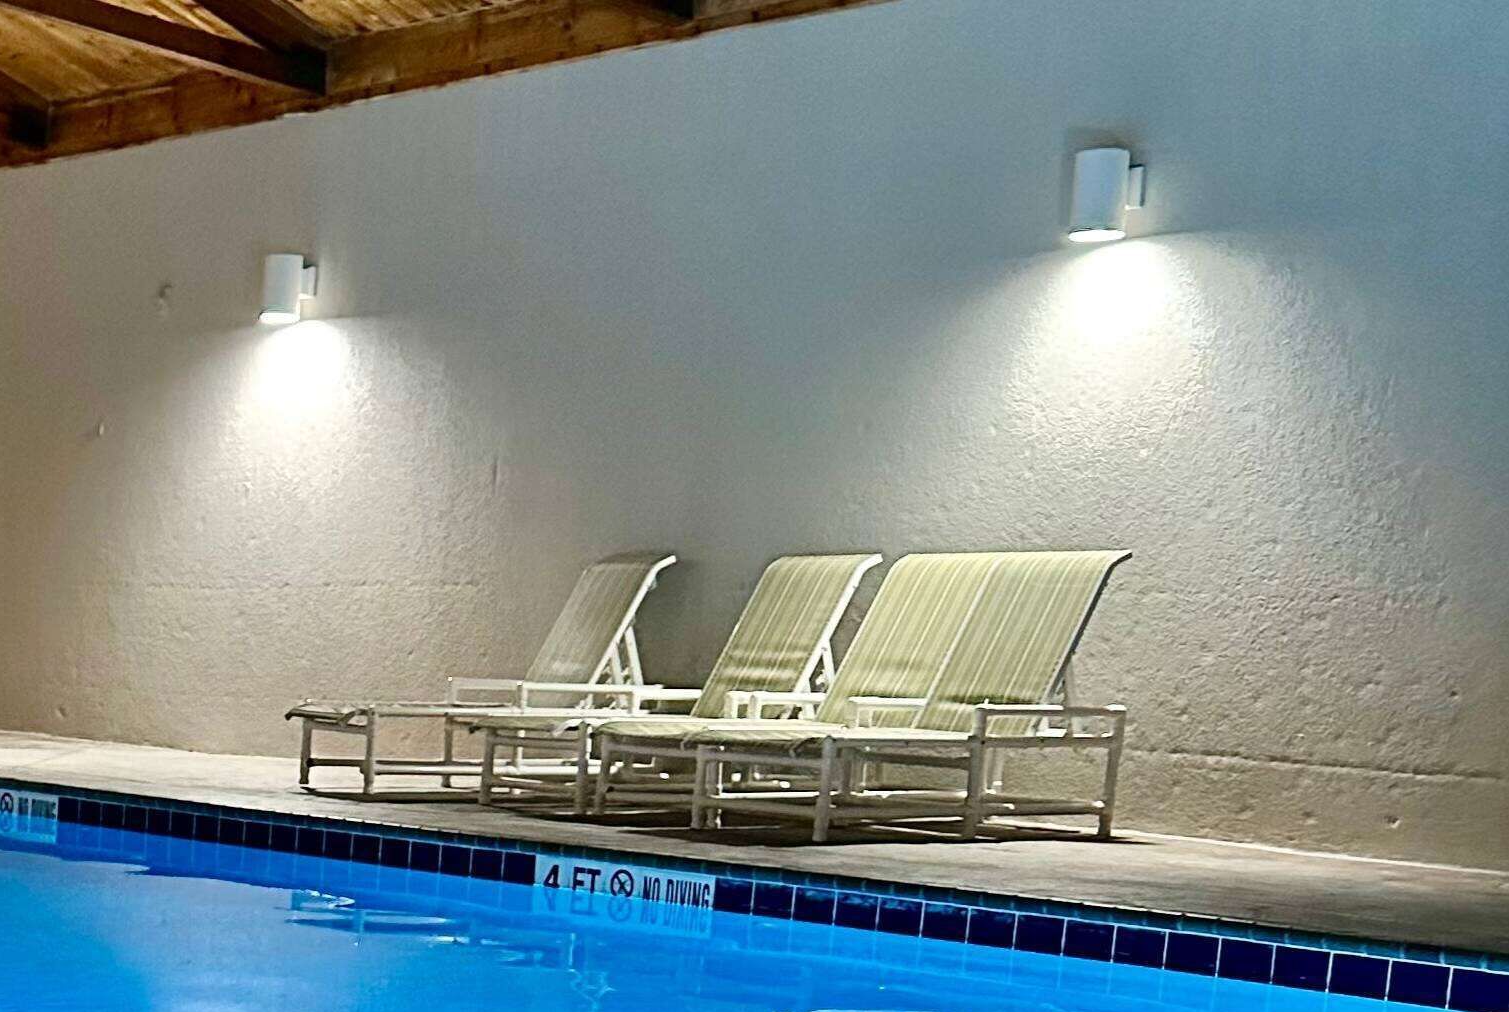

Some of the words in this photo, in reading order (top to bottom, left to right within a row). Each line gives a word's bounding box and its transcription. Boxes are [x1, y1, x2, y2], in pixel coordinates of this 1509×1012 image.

[543, 864, 560, 888] 4
[572, 866, 601, 894] FT
[643, 875, 660, 903] NO
[666, 878, 710, 908] DIVING
